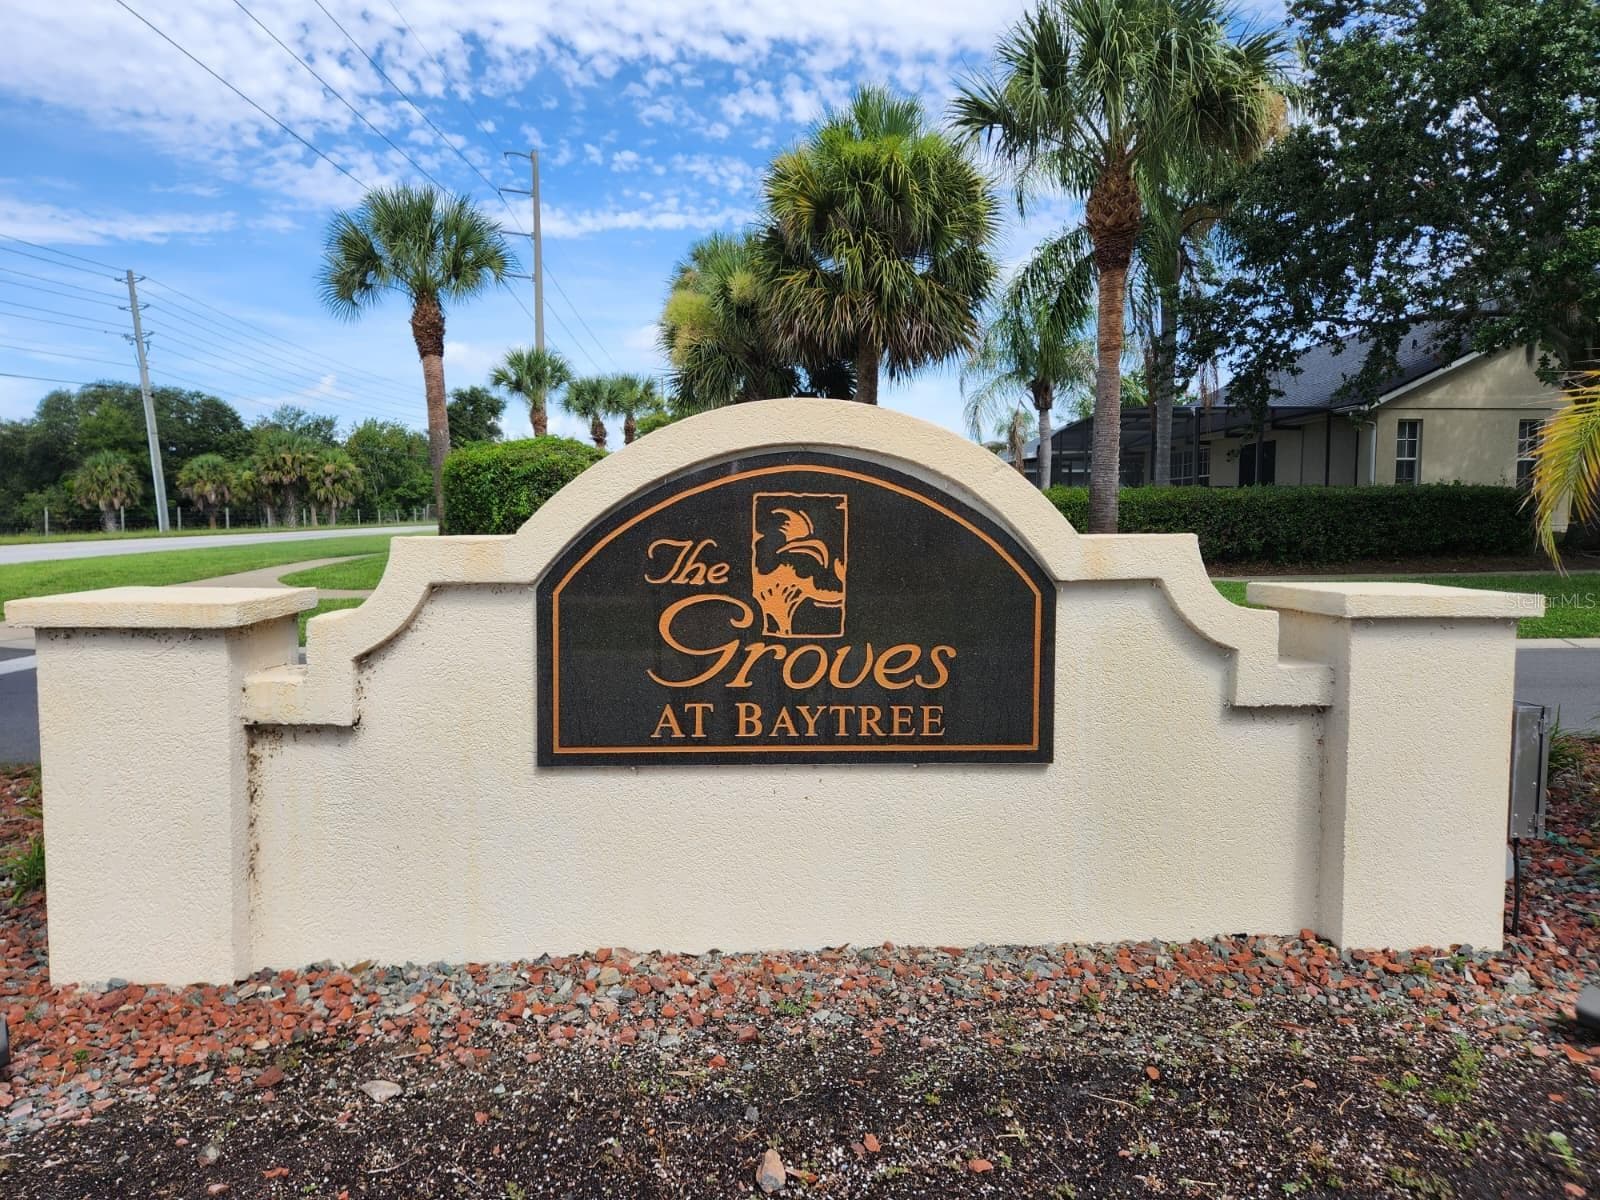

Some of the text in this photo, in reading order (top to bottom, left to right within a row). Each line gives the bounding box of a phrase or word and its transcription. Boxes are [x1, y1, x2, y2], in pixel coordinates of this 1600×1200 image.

[645, 539, 729, 585] The
[648, 594, 957, 689] Groves
[651, 703, 945, 737] AT BAYTREE
